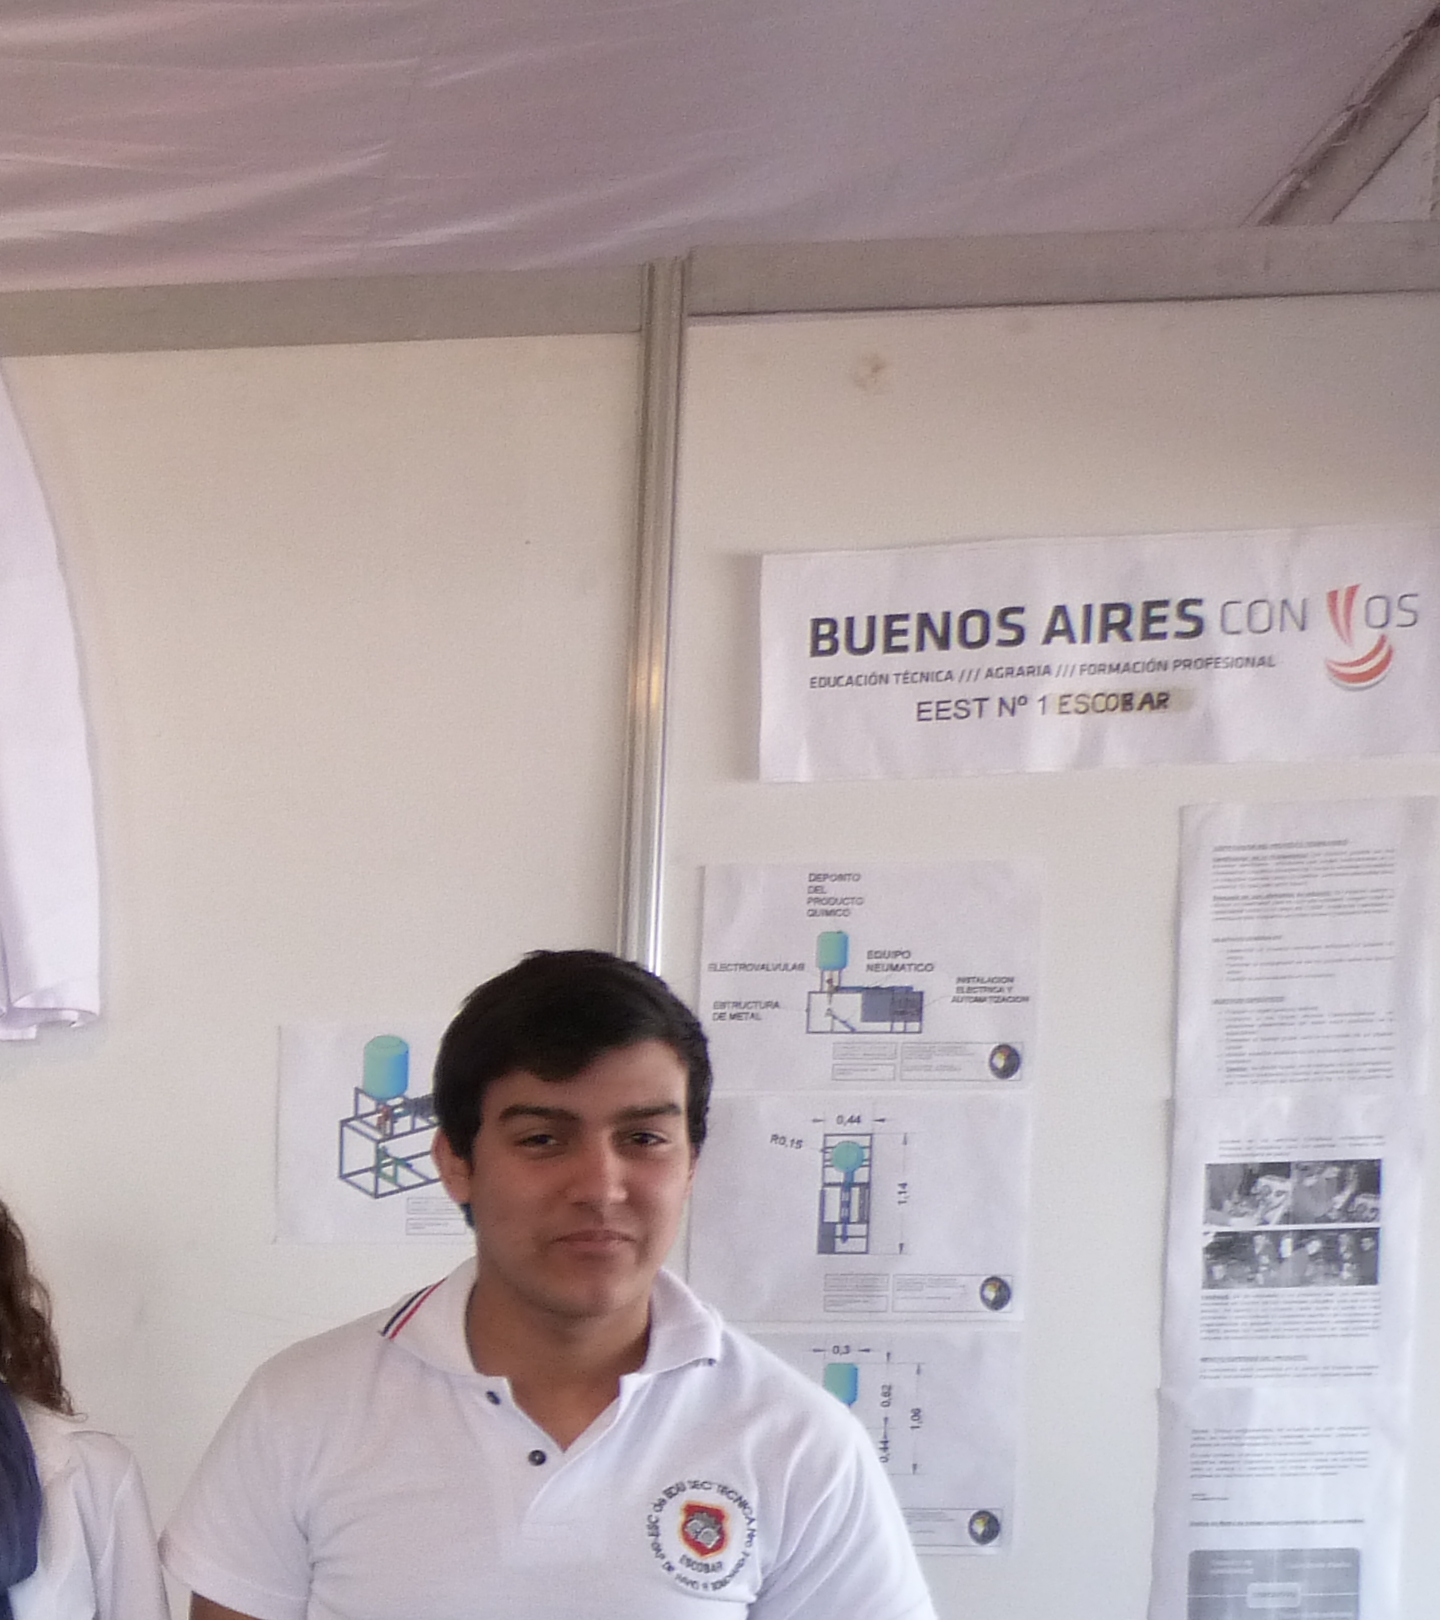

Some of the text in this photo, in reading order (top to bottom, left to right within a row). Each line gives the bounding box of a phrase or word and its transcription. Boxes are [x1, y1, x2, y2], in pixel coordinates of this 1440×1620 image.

[809, 605, 1026, 659] BUENOS
[1042, 597, 1204, 645] AIRES
[1220, 597, 1309, 636] CON
[809, 670, 890, 689] EDUCACIÓN
[893, 668, 954, 685] TÉCNICA
[984, 664, 1051, 680] AGRARIA
[1078, 659, 1168, 677] FORMACIÓN
[1172, 654, 1276, 671] PROFESIONAL
[917, 692, 1170, 722] EEST Nº 1 ESCOBAR
[866, 963, 934, 972] NEUMATICO
[867, 950, 911, 959] EQUIPO
